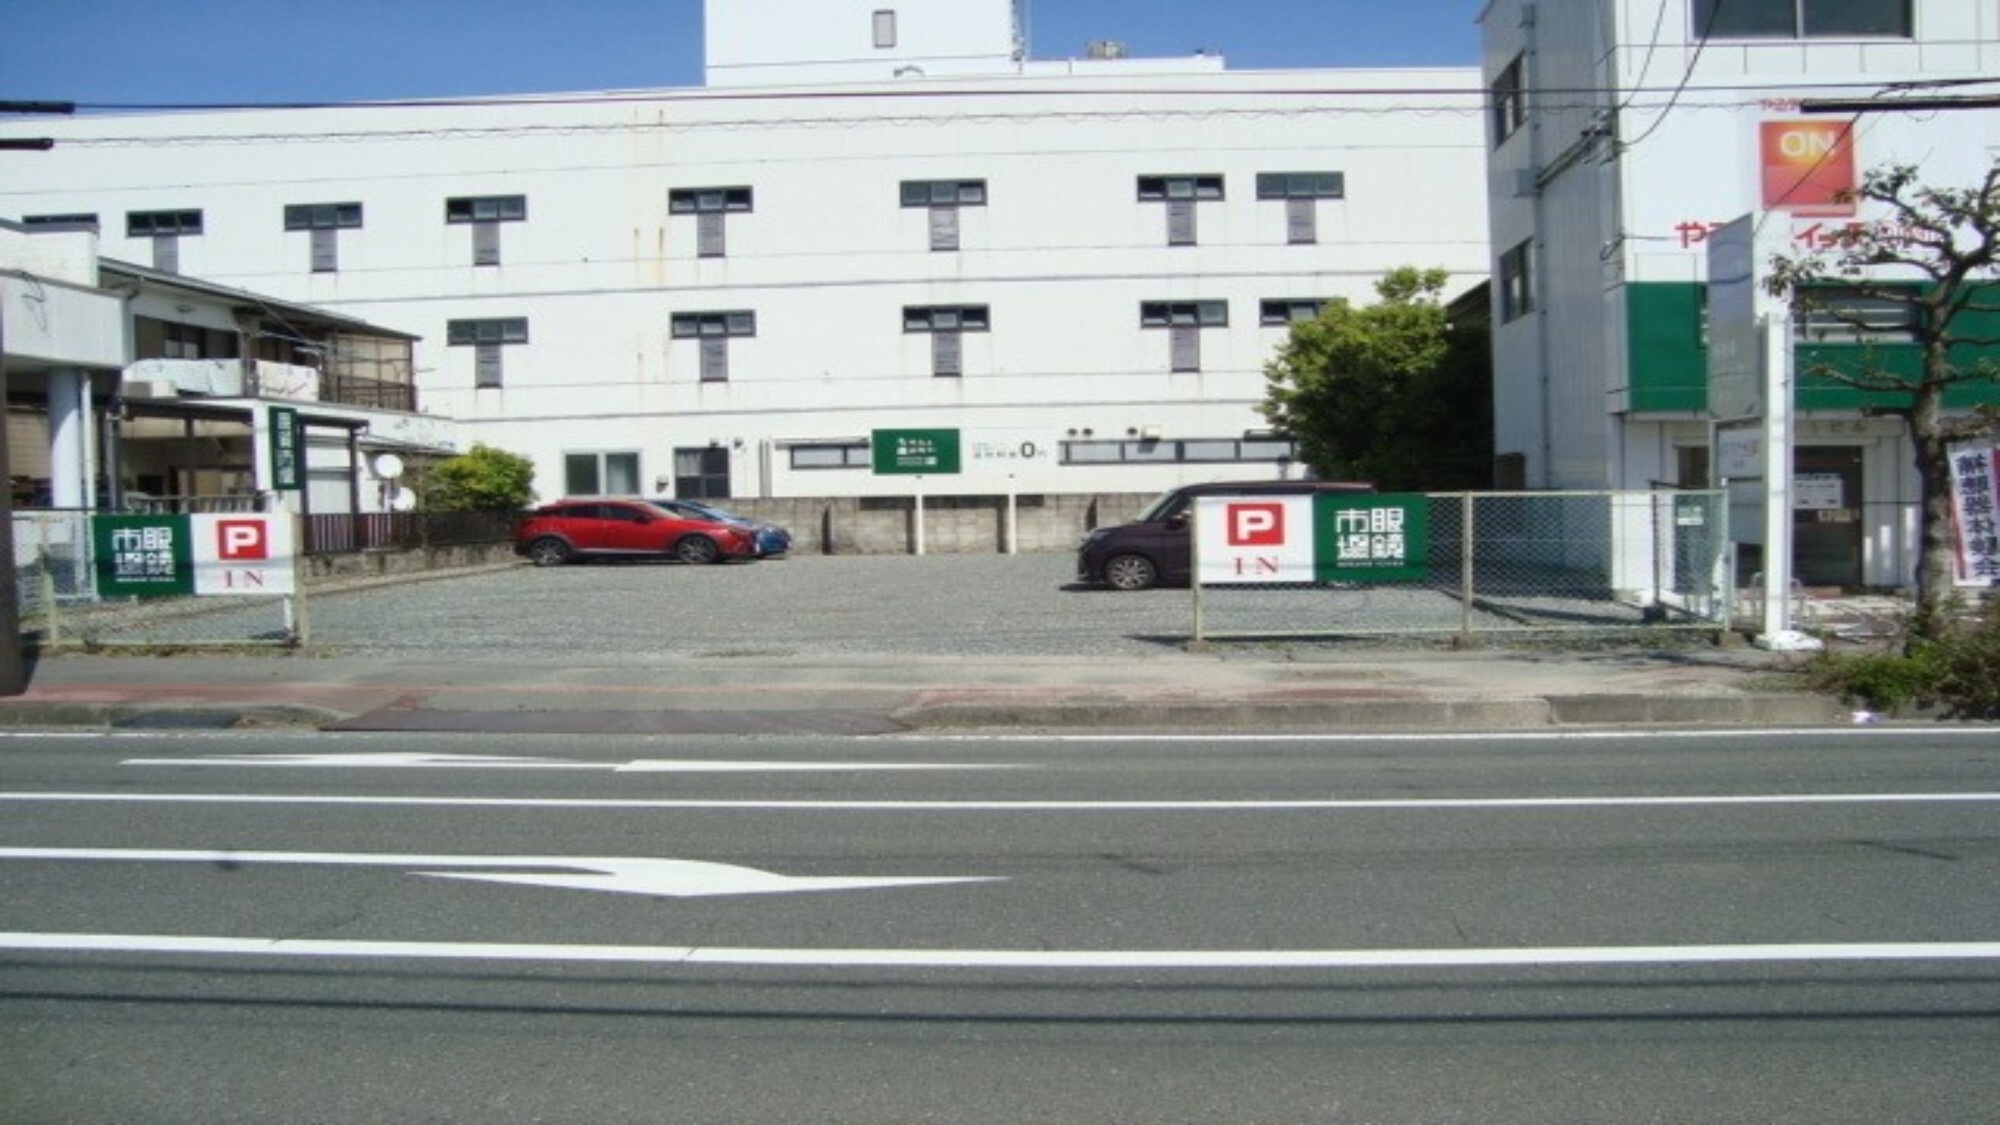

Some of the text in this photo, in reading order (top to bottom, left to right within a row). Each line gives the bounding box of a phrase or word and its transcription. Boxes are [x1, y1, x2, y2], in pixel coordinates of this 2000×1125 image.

[1780, 130, 1835, 156] ON
[1237, 510, 1275, 540] P
[225, 526, 258, 554] P
